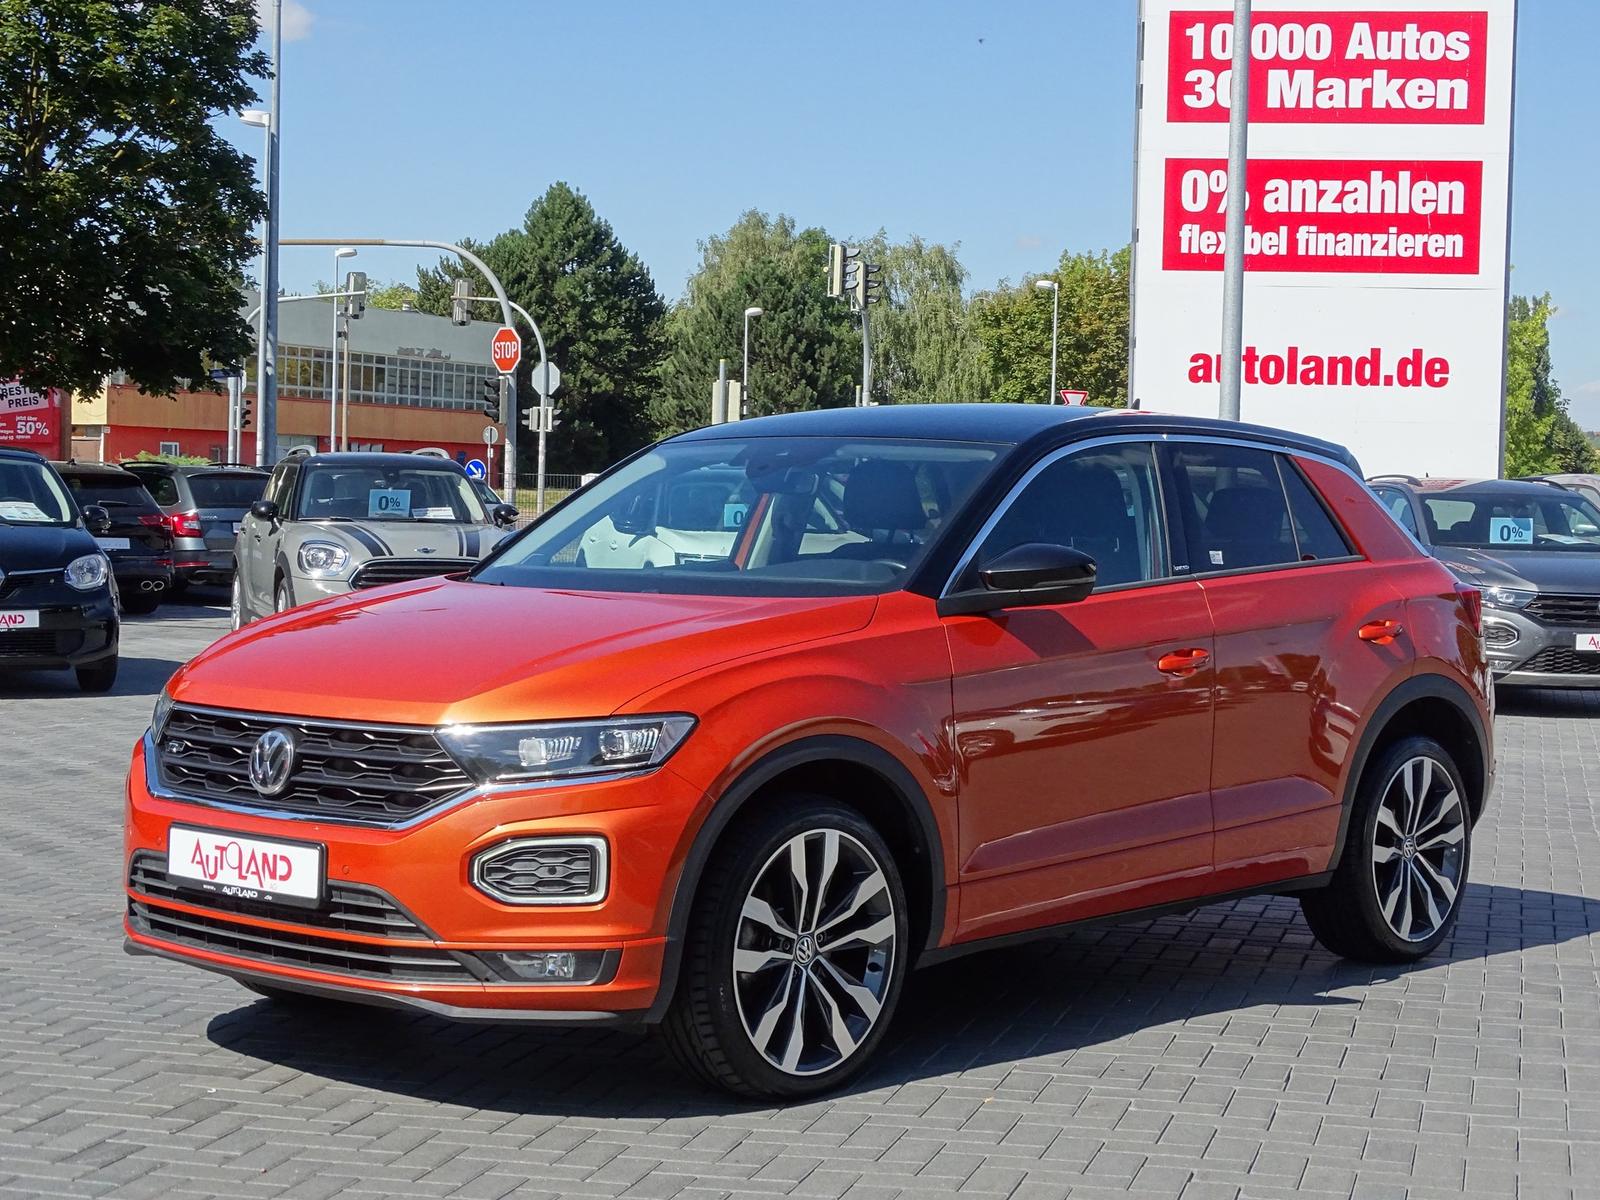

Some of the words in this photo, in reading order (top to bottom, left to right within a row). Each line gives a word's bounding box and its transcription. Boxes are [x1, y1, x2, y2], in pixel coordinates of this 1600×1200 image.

[1345, 22, 1470, 61] Autos
[1267, 69, 1469, 110] Marken
[1263, 170, 1465, 215] anzahlen
[1179, 224, 1288, 256] flexbel
[1296, 225, 1464, 258] finanzieren
[494, 341, 518, 359] STOP
[1188, 346, 1450, 388] atoland.de
[8, 396, 39, 408] PREIS
[17, 421, 49, 435] 50%
[378, 496, 401, 511] 0%
[1500, 525, 1524, 541] 0%
